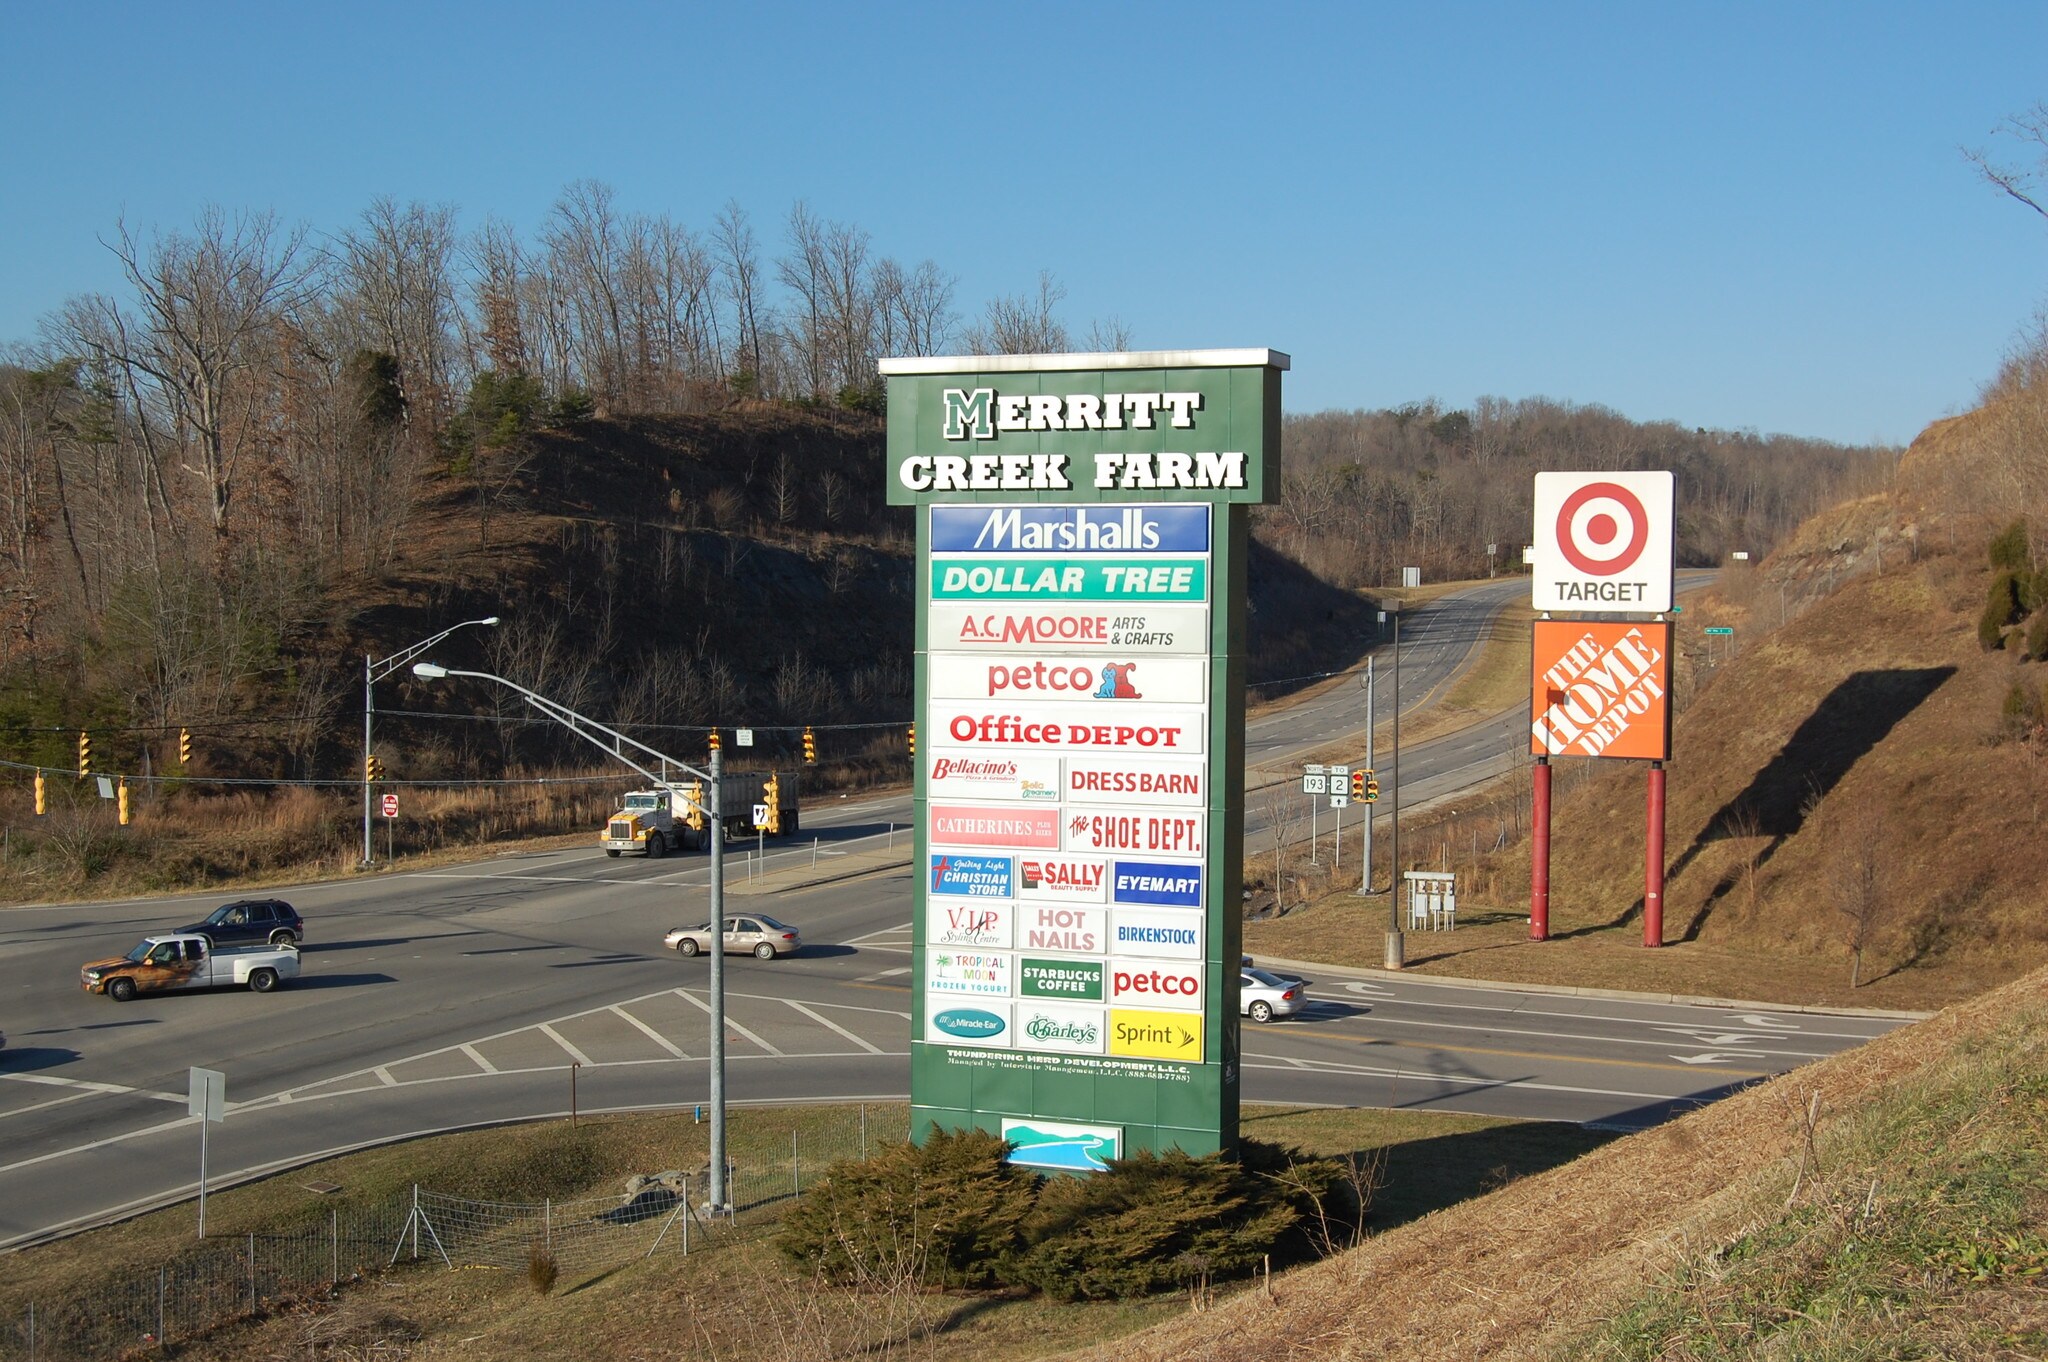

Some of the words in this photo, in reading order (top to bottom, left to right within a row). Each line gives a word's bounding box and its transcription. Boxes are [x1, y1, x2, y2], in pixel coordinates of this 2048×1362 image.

[943, 388, 1200, 439] MERRITT
[899, 454, 1069, 490] CREEK
[1094, 452, 1244, 488] FARM
[973, 509, 1160, 549] Marshalls
[942, 567, 1085, 592] DOLLAR
[1102, 567, 1193, 592] TREE
[1555, 582, 1647, 601] TARGET
[1112, 617, 1145, 630] ARTS
[1111, 633, 1120, 645] &
[1125, 632, 1173, 646] CRAFTS
[1543, 632, 1604, 691] THE
[988, 662, 1093, 696] petco
[1532, 627, 1661, 755] HOME
[1577, 671, 1663, 756] DEPOT
[950, 715, 1061, 744] Office
[1068, 726, 1180, 747] DEPOT
[932, 758, 1017, 779] Bellacino's
[1306, 779, 1323, 790] 193
[1336, 780, 1343, 791] 2
[937, 818, 1032, 836] CATHERINES
[1069, 816, 1089, 839] the
[1092, 816, 1140, 850] SHOE
[1149, 819, 1200, 851] DEPT.
[986, 860, 1005, 870] Light
[1045, 862, 1104, 886] SALLY
[944, 872, 1008, 884] CHRISTIAN
[1117, 876, 1199, 894] EYEMART
[968, 884, 1005, 896] STORE
[1038, 909, 1086, 929] HOT
[941, 930, 973, 944] Styling
[1029, 930, 1094, 950] NAILS
[1118, 926, 1196, 945] BIRKENSTOCK
[956, 955, 1004, 968] TROPICAL
[963, 969, 995, 981] MOON
[1023, 967, 1100, 982] STARBUCKS
[1114, 970, 1198, 996] petco
[931, 981, 966, 990] FROZEN
[971, 983, 1007, 993] YOGURT
[1038, 980, 1086, 992] COFFEE
[956, 1018, 998, 1029] Miracle-Ear
[1026, 1015, 1096, 1042] O'Charley's
[1117, 1022, 1172, 1045] Sprint
[947, 1049, 1024, 1061] THUNDERING
[1027, 1055, 1060, 1064] HERD
